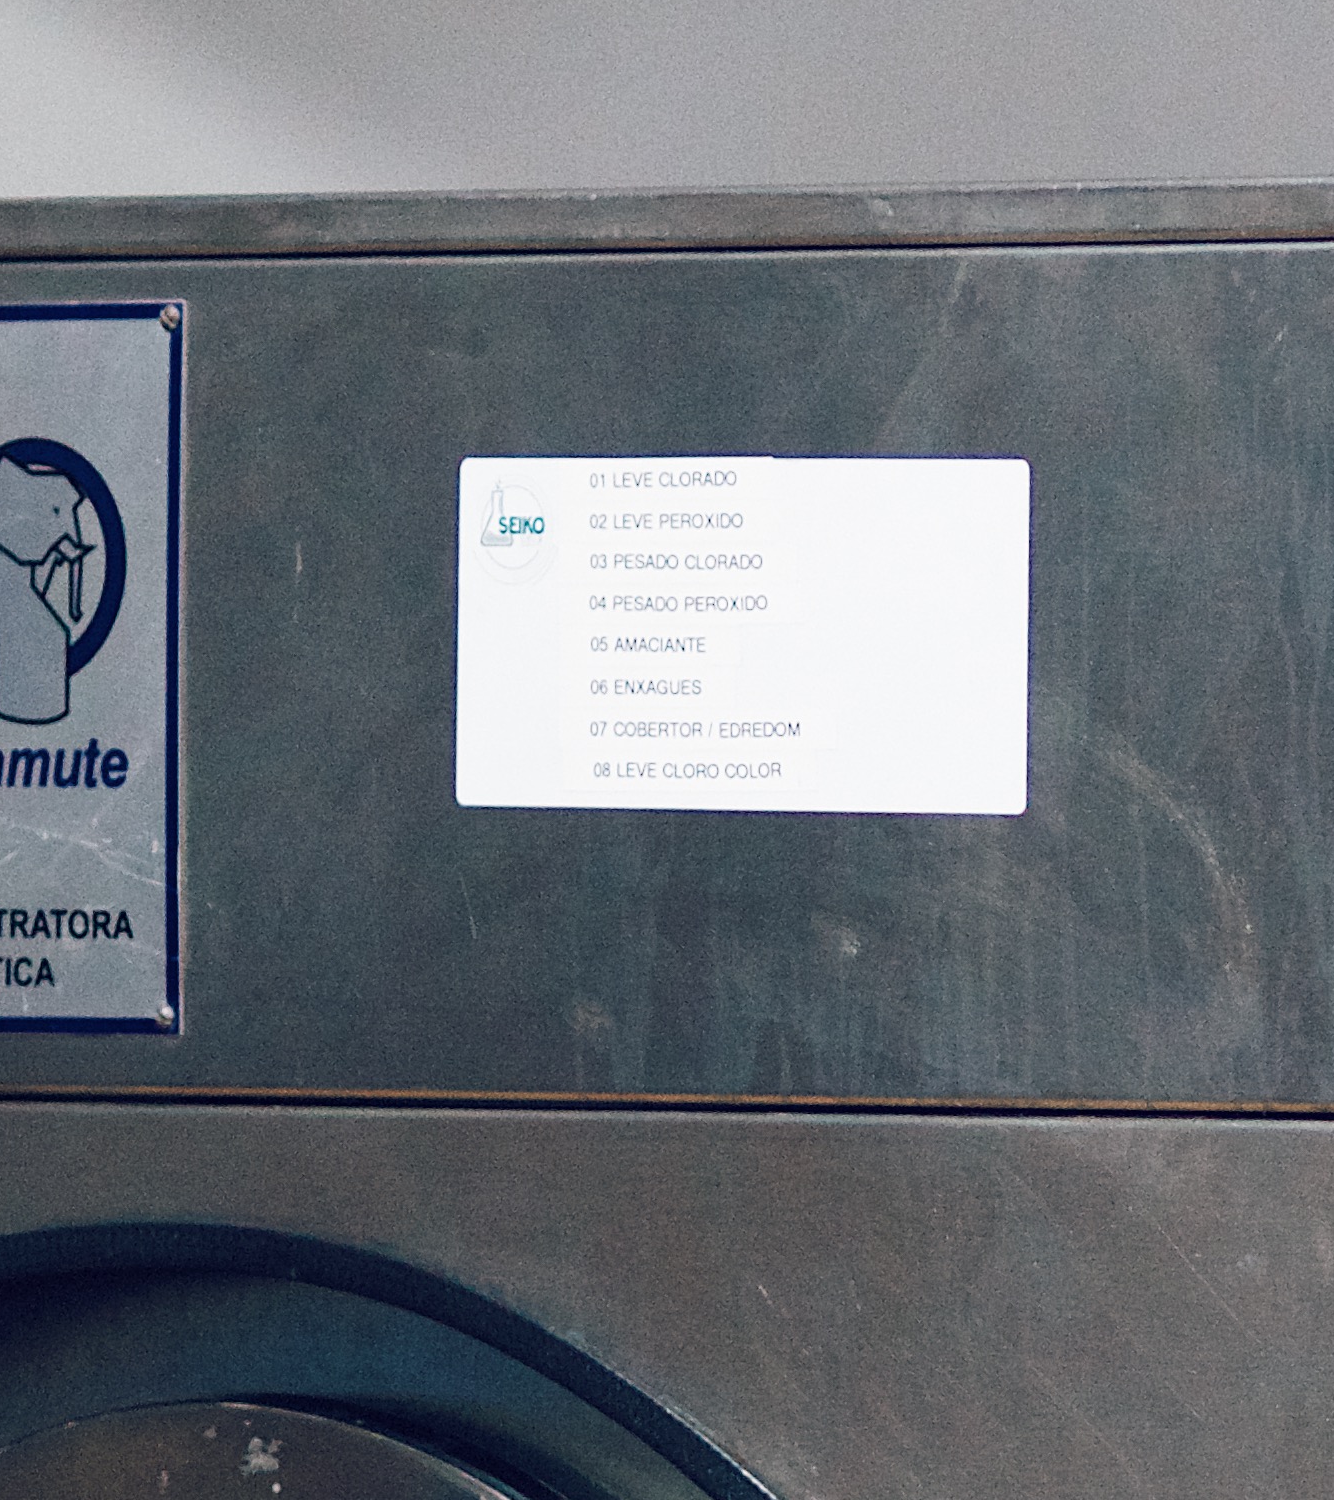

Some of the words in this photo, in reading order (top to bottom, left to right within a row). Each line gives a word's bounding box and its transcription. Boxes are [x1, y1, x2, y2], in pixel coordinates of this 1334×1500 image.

[589, 473, 606, 489] 01
[613, 472, 653, 489] LEVE
[658, 470, 737, 488] CLORADO
[589, 514, 607, 530] 02
[613, 513, 653, 530] LEVE
[659, 512, 744, 530] PEROXIDO
[589, 554, 607, 570] 03
[613, 553, 679, 571] PESADO
[684, 553, 763, 571] CLORADO
[589, 595, 607, 611] 04
[613, 595, 679, 612] PESADO
[684, 595, 768, 612] PEROXIDO
[589, 636, 608, 653] 05
[614, 636, 706, 653] AMACIANTE
[589, 679, 608, 696] 06
[614, 678, 702, 696] ENXAGUES
[589, 721, 607, 738] 07
[613, 720, 703, 738] COBERTOR
[719, 721, 801, 739] EDREDOM
[593, 762, 611, 779] 08
[616, 762, 657, 779] LEVE
[662, 762, 719, 780] CLORO
[724, 762, 782, 780] COLOR
